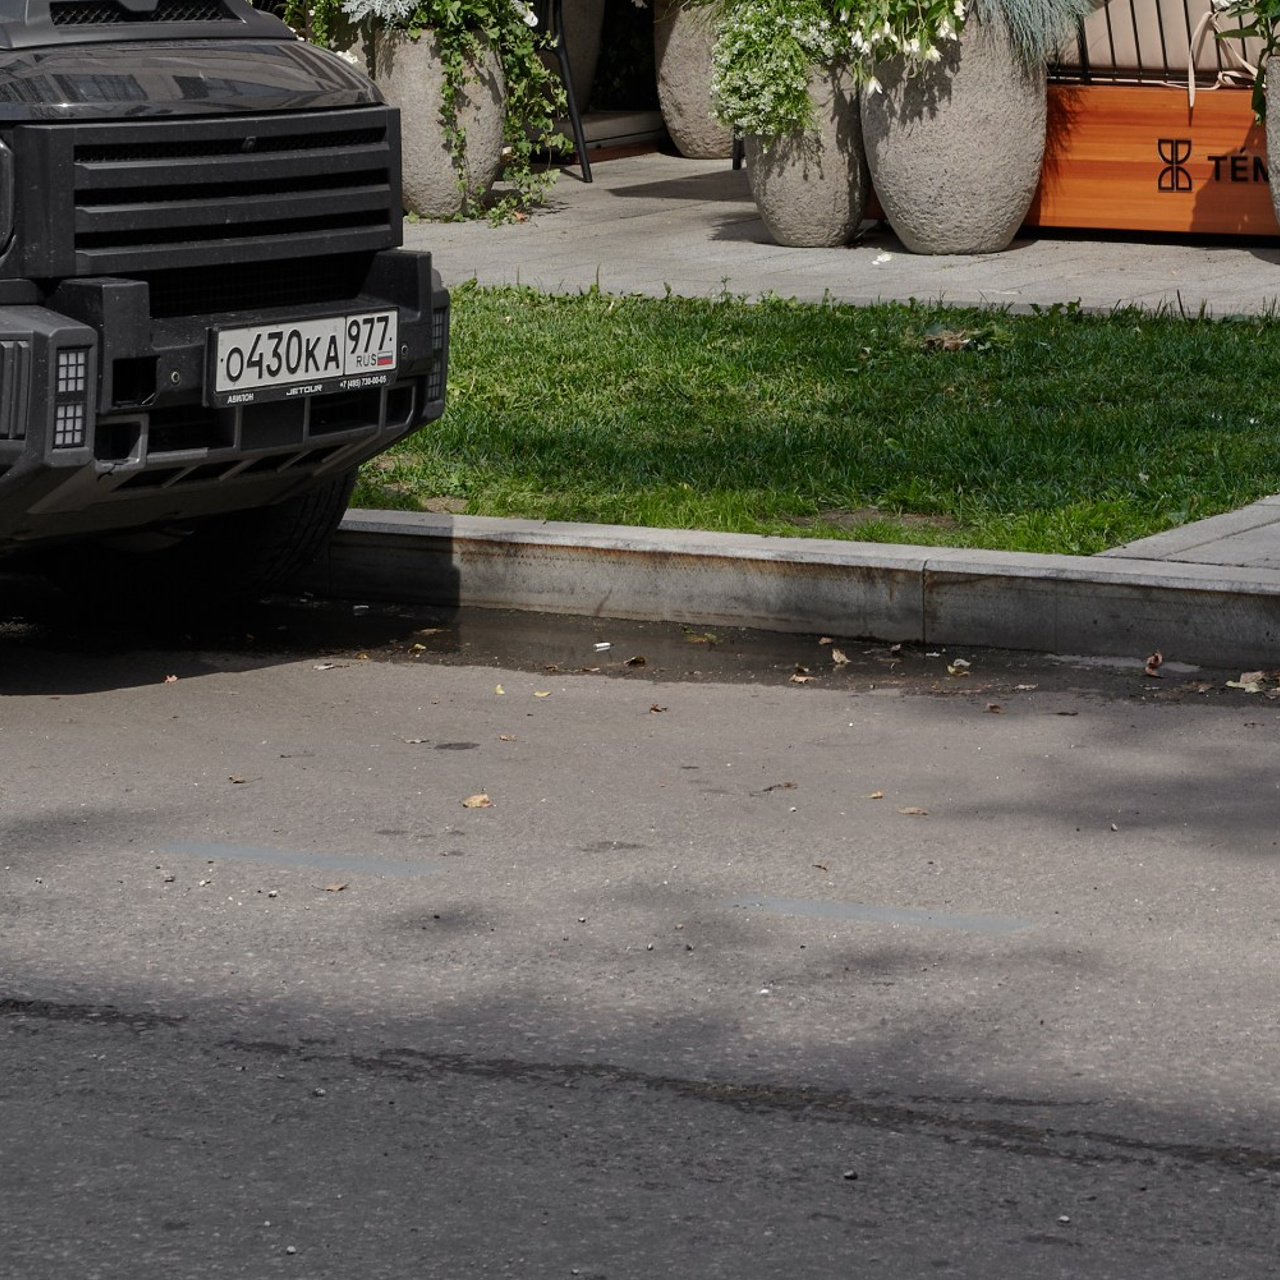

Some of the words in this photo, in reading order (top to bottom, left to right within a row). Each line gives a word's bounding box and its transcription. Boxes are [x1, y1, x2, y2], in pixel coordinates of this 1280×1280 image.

[347, 315, 390, 355] 977
[356, 354, 377, 368] RUS
[286, 384, 322, 396] JETOUR
